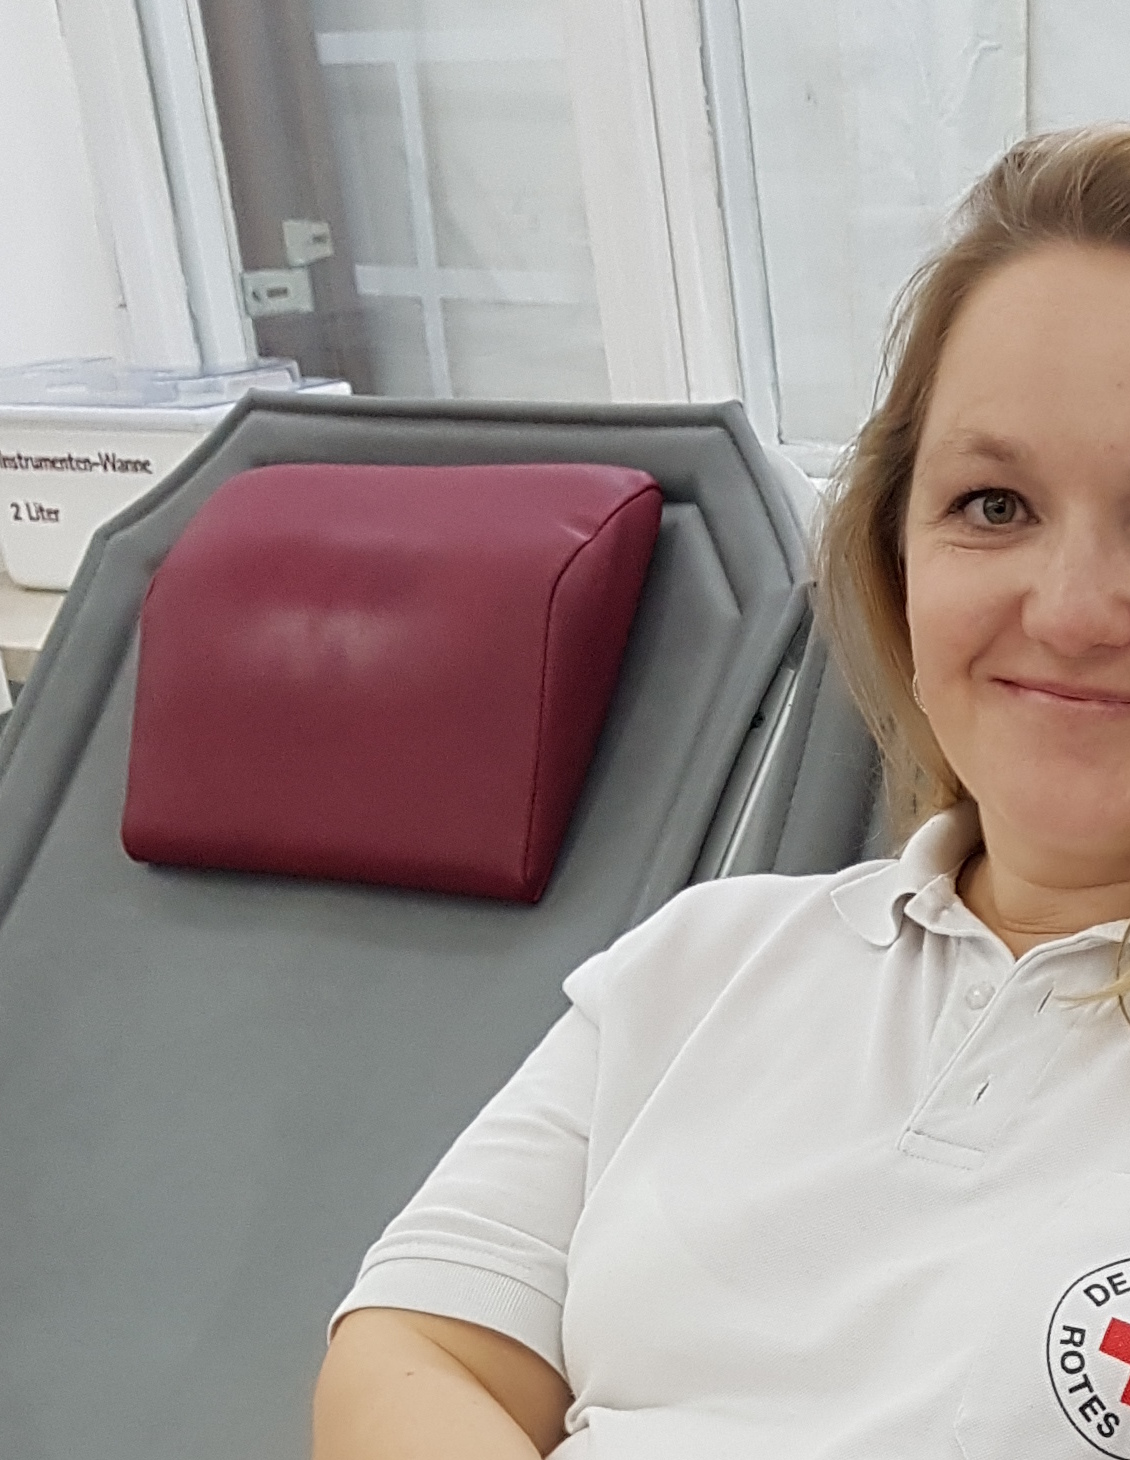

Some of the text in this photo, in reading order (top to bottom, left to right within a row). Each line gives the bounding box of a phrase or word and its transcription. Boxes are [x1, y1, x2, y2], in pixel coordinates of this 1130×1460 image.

[10, 500, 60, 522] 2 Liter
[1060, 1325, 1120, 1438] ROTES
